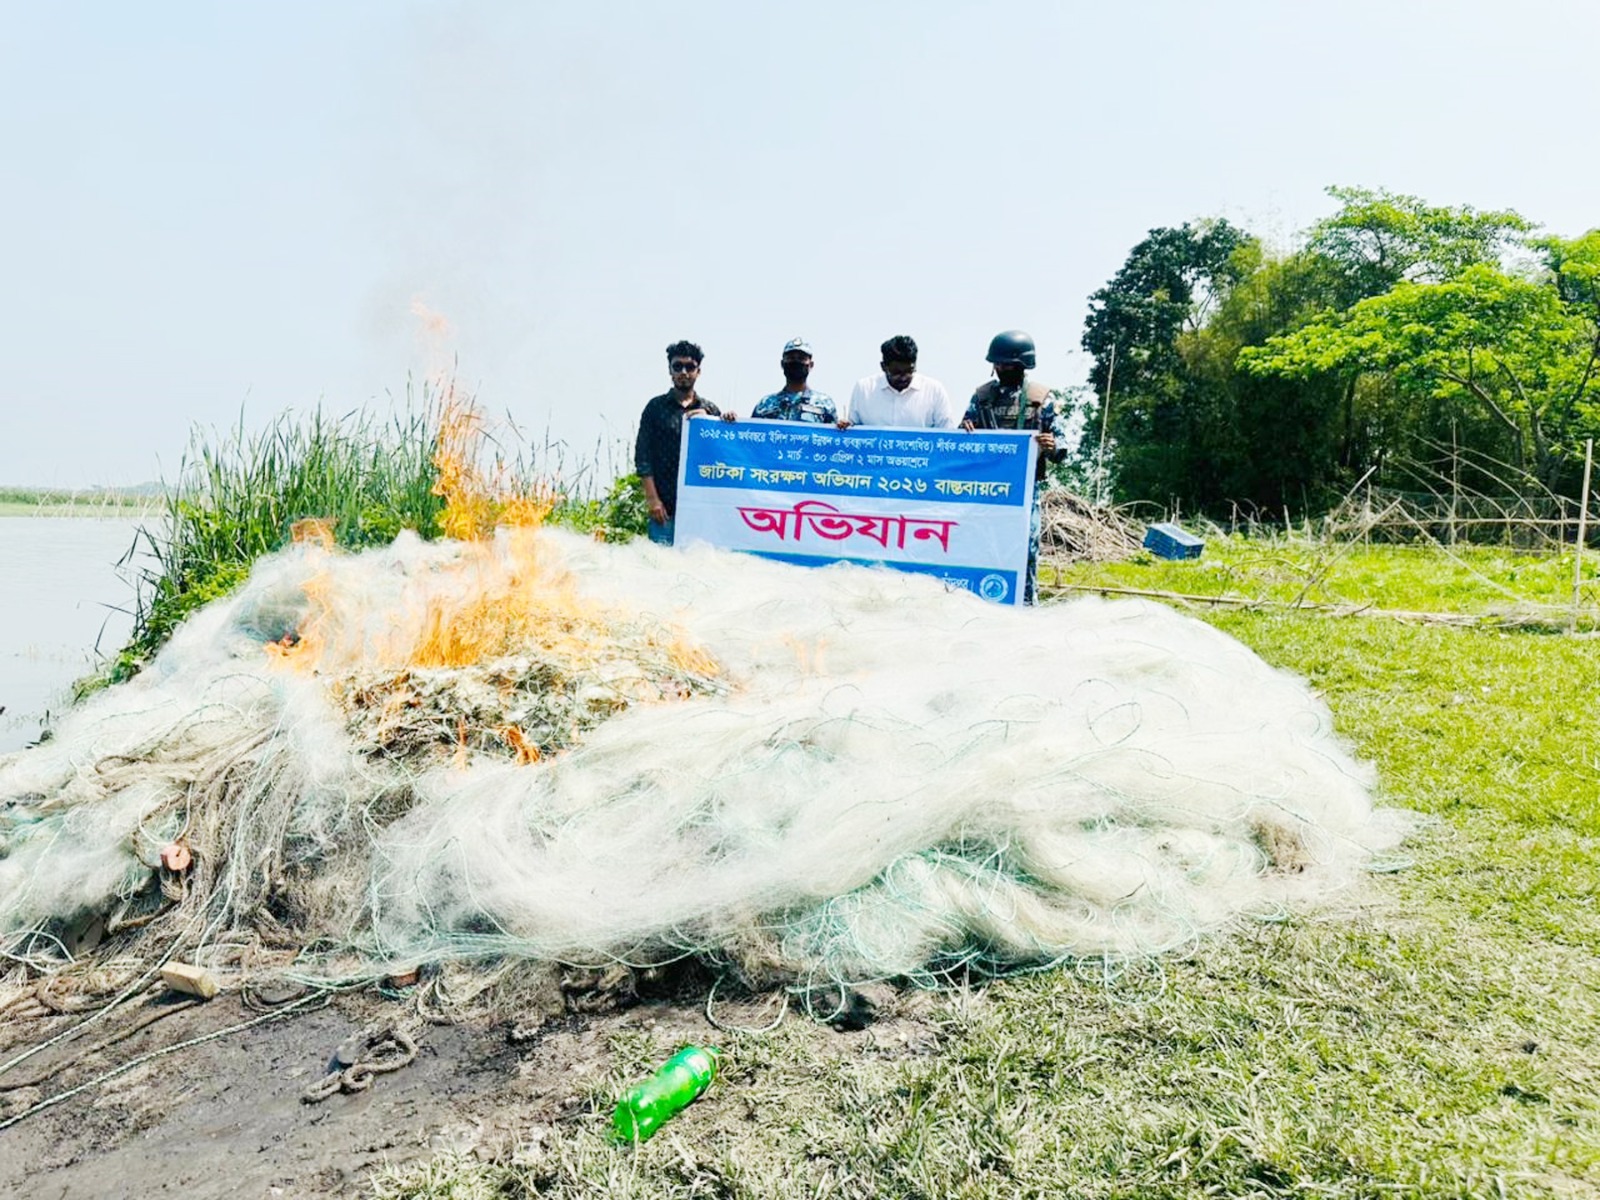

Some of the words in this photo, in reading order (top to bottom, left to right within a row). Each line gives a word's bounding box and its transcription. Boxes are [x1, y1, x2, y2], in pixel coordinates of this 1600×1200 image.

[699, 428, 736, 441] ২০২৫-২৬
[834, 437, 841, 446] ও
[936, 438, 956, 453] শীর্ষক
[777, 450, 784, 460] ১
[787, 448, 803, 461] মার্চ
[813, 453, 827, 463] ৩০
[830, 451, 855, 464] এপ্রিল
[857, 456, 864, 466] ২
[867, 456, 883, 466] মাস
[886, 456, 929, 469] অভয়াশ্রমে
[698, 461, 746, 481] জাটকা
[750, 467, 807, 485] সংরক্ষণ
[812, 469, 873, 489] অভিযান
[877, 476, 928, 494] ২০২৬
[934, 478, 1012, 498] বাস্তবায়নে
[736, 500, 960, 553] অভিযান
